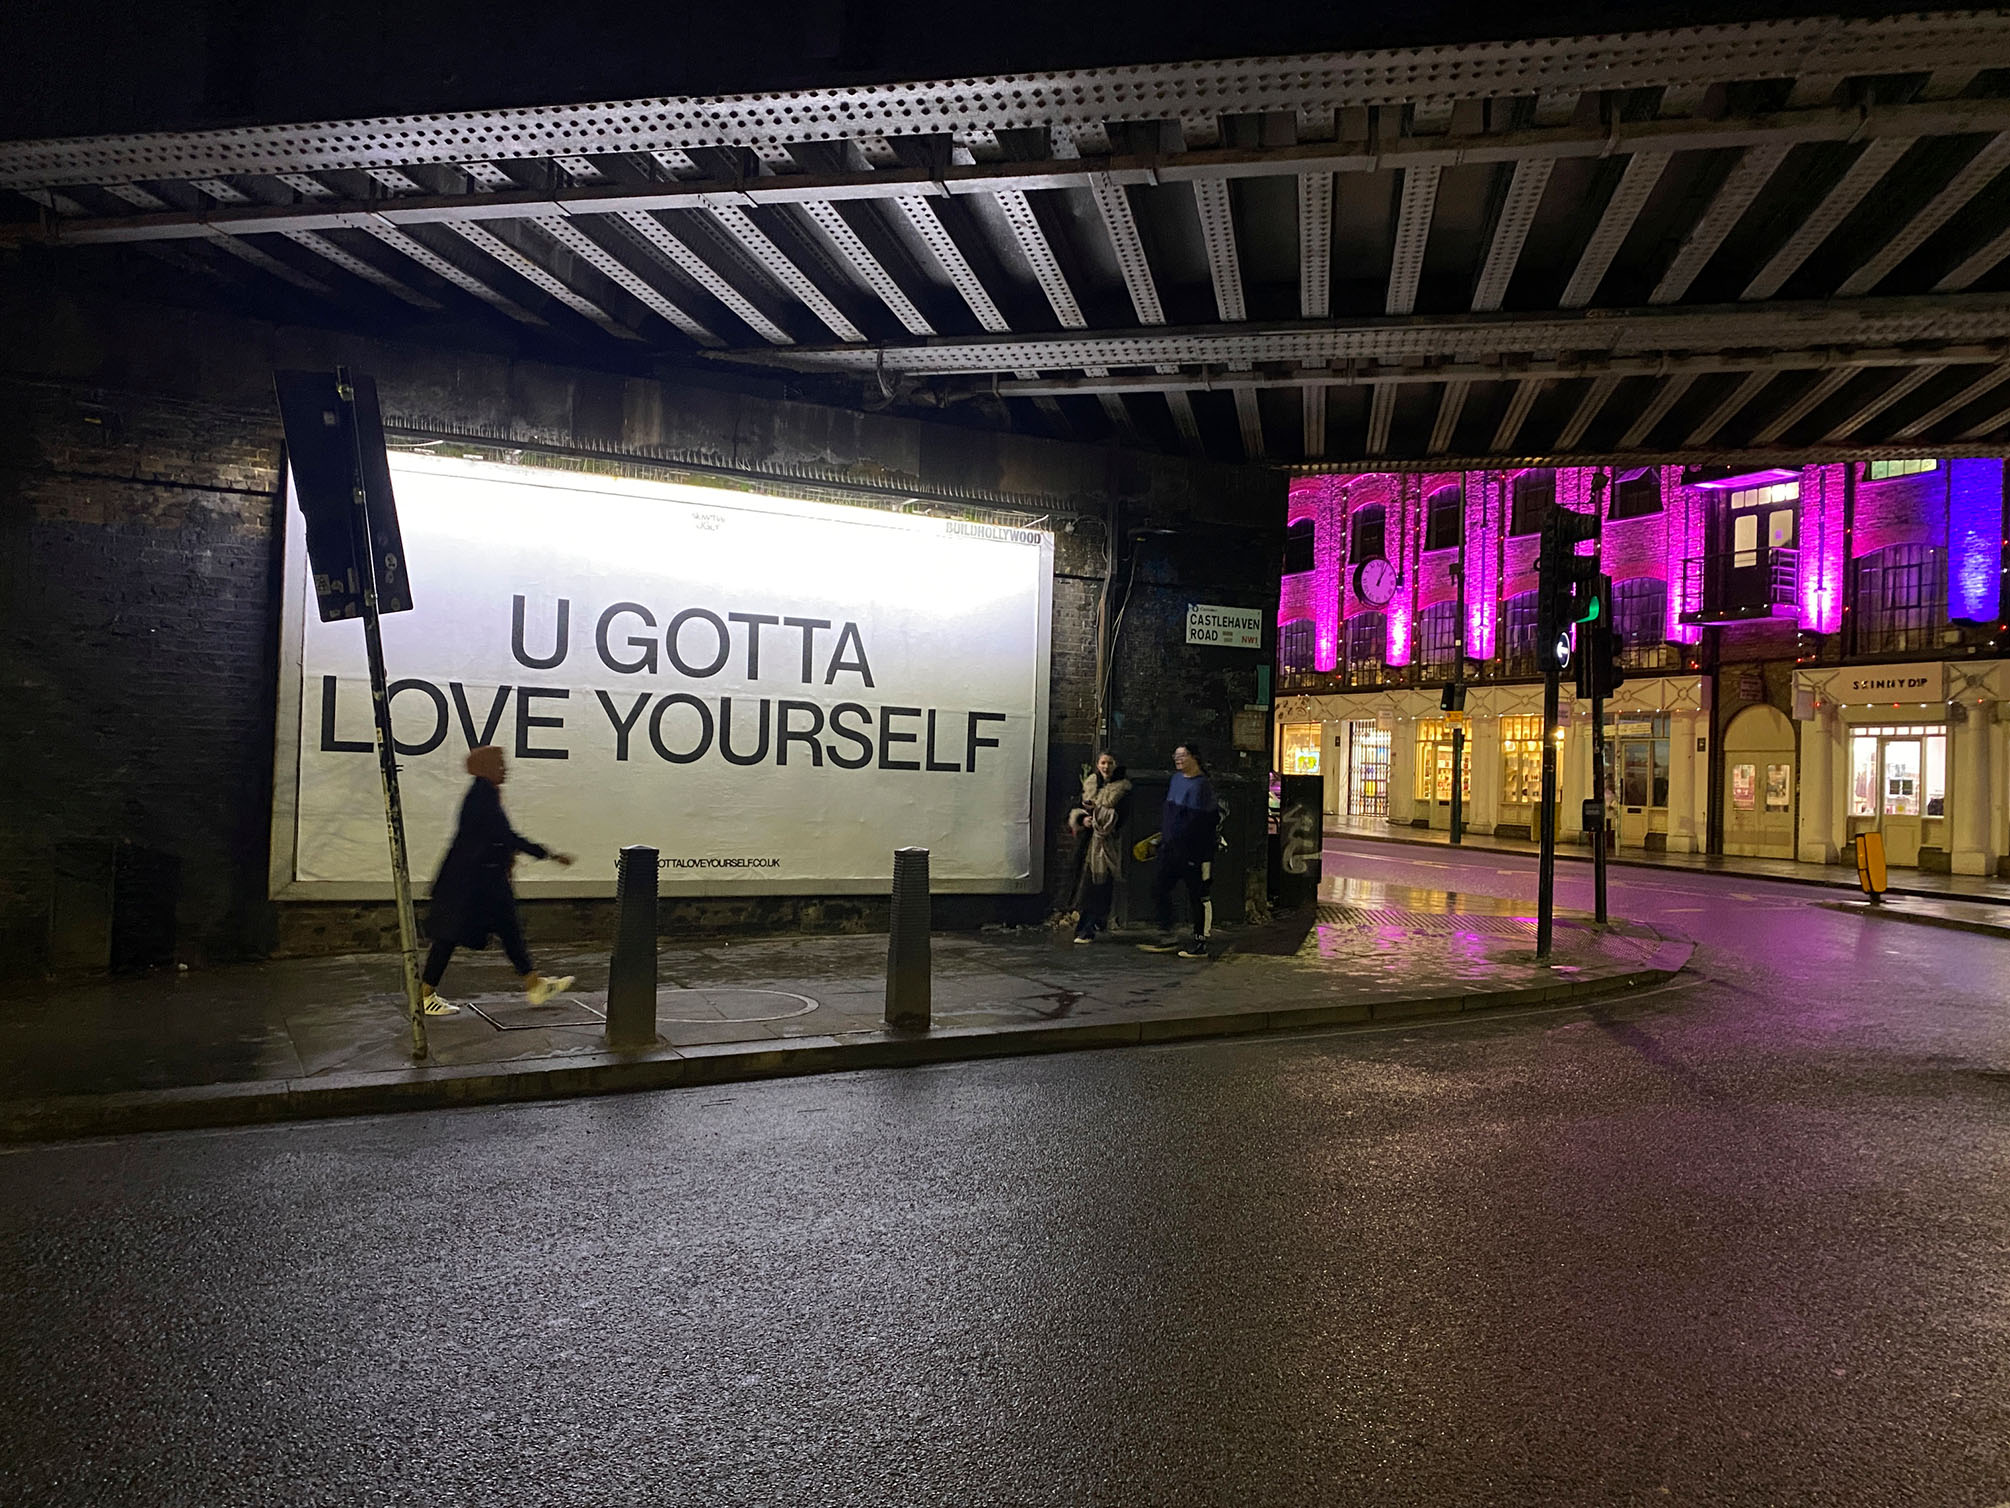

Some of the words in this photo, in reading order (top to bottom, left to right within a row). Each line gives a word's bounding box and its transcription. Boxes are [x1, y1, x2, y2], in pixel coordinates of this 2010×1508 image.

[946, 521, 1041, 544] BUILDHOLLYWOOD
[1190, 613, 1260, 630] CASTLEHAVEN
[511, 594, 570, 670] U
[595, 601, 876, 688] GOTTA
[1190, 628, 1218, 641] ROAD
[1241, 635, 1258, 644] NW1
[320, 675, 570, 760] LOVE
[594, 690, 1006, 773] YOURSELF
